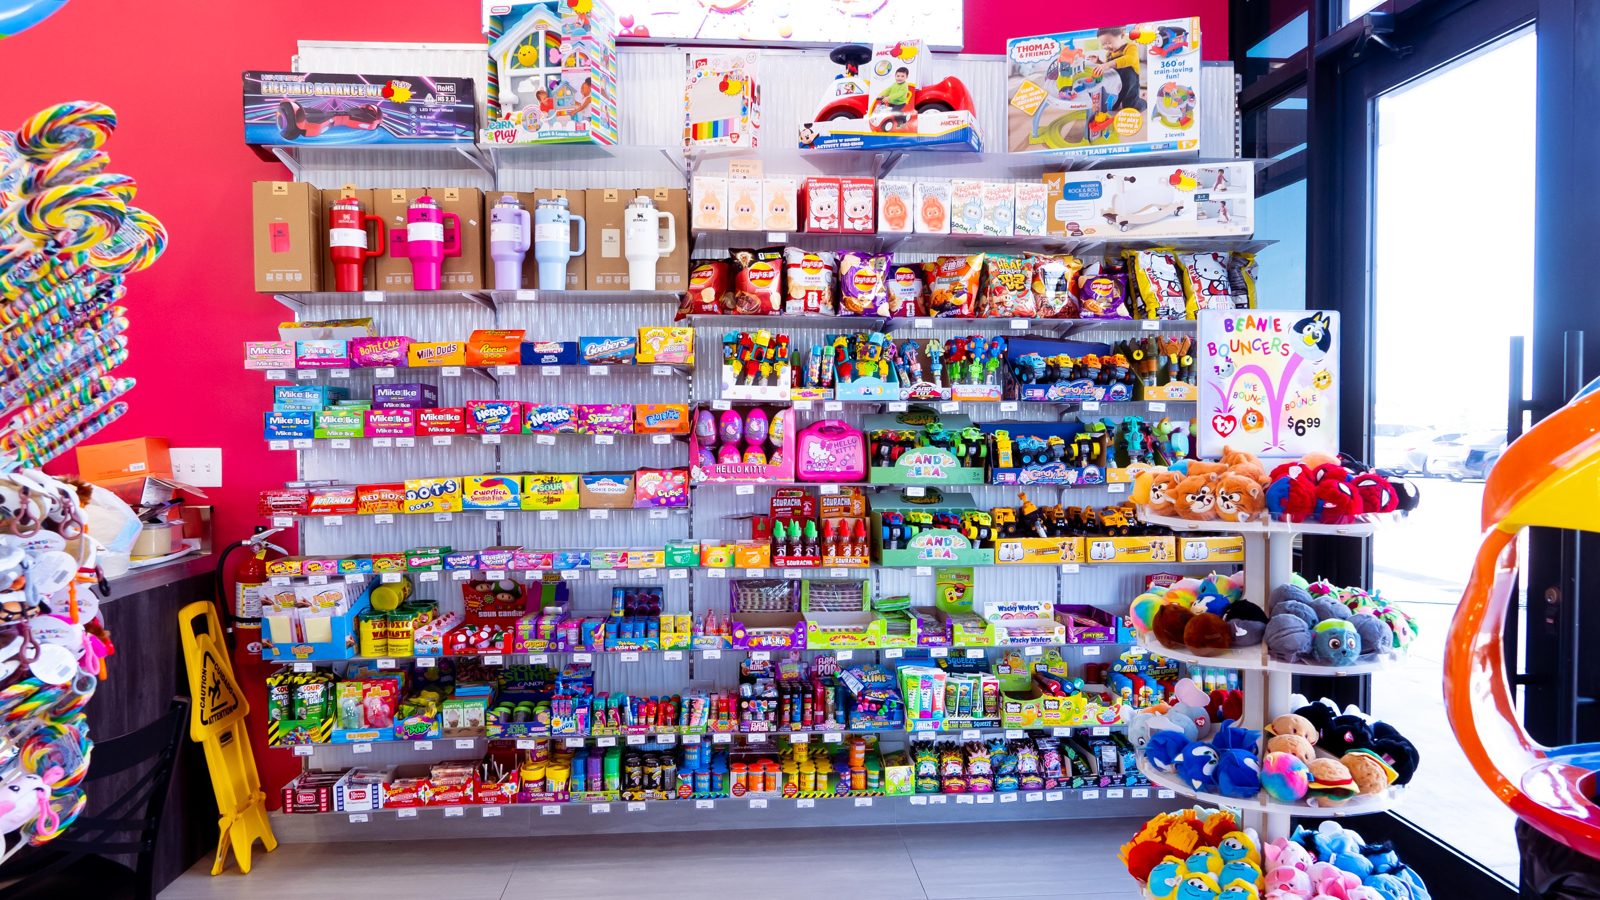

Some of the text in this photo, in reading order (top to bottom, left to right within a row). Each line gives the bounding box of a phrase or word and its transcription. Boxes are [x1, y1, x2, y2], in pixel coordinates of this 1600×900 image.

[1016, 42, 1055, 53] THOMAS
[1025, 50, 1053, 58] FRIENDS
[1153, 66, 1194, 75] train-loving
[261, 82, 313, 96] ELECTRIC
[315, 83, 365, 97] BALANCE
[437, 84, 454, 92] RoHS
[494, 129, 517, 143] Play
[997, 259, 1022, 270] HBAF
[1224, 314, 1282, 332] BEANIE
[250, 347, 291, 355] Mike Ike
[304, 347, 337, 355] Mike Ike
[359, 339, 400, 356] BOTTLE CAPS
[417, 344, 457, 359] Milk Duds
[585, 337, 630, 356] Goobers
[1207, 337, 1290, 357] BOUNCERS
[1057, 386, 1083, 396] Candy
[1243, 381, 1257, 391] WE
[1233, 391, 1266, 405] BOUNCE
[1285, 394, 1317, 411] BOUNCE
[269, 417, 293, 425] Mike
[319, 416, 360, 424] Mike Ike
[396, 415, 410, 423] Ike
[420, 413, 443, 421] Mike
[588, 414, 624, 424] Spree
[1214, 415, 1234, 434] ty
[833, 438, 858, 448] HELLO
[835, 444, 858, 454] KITTY
[904, 453, 952, 466] CANDY
[715, 465, 767, 474] HELLO KITTY
[914, 466, 941, 477] ERA
[1028, 469, 1054, 481] Candy
[406, 480, 456, 499] DOTS
[539, 482, 564, 491] SOUR
[409, 501, 433, 511] DOTS
[773, 499, 801, 507] SOURACHA
[823, 498, 851, 506] SOURACHA
[915, 535, 962, 548] CANDY
[925, 549, 951, 559] ERA
[998, 604, 1016, 612] Wacky
[388, 621, 411, 629] OXIC
[947, 657, 977, 665] SQUEEZE
[509, 664, 546, 672] SOUR
[818, 665, 837, 675] POP
[214, 663, 233, 694] CUIDADO
[200, 668, 208, 708] CAUTION
[303, 684, 320, 692] SOUR
[272, 693, 288, 701] Smo
